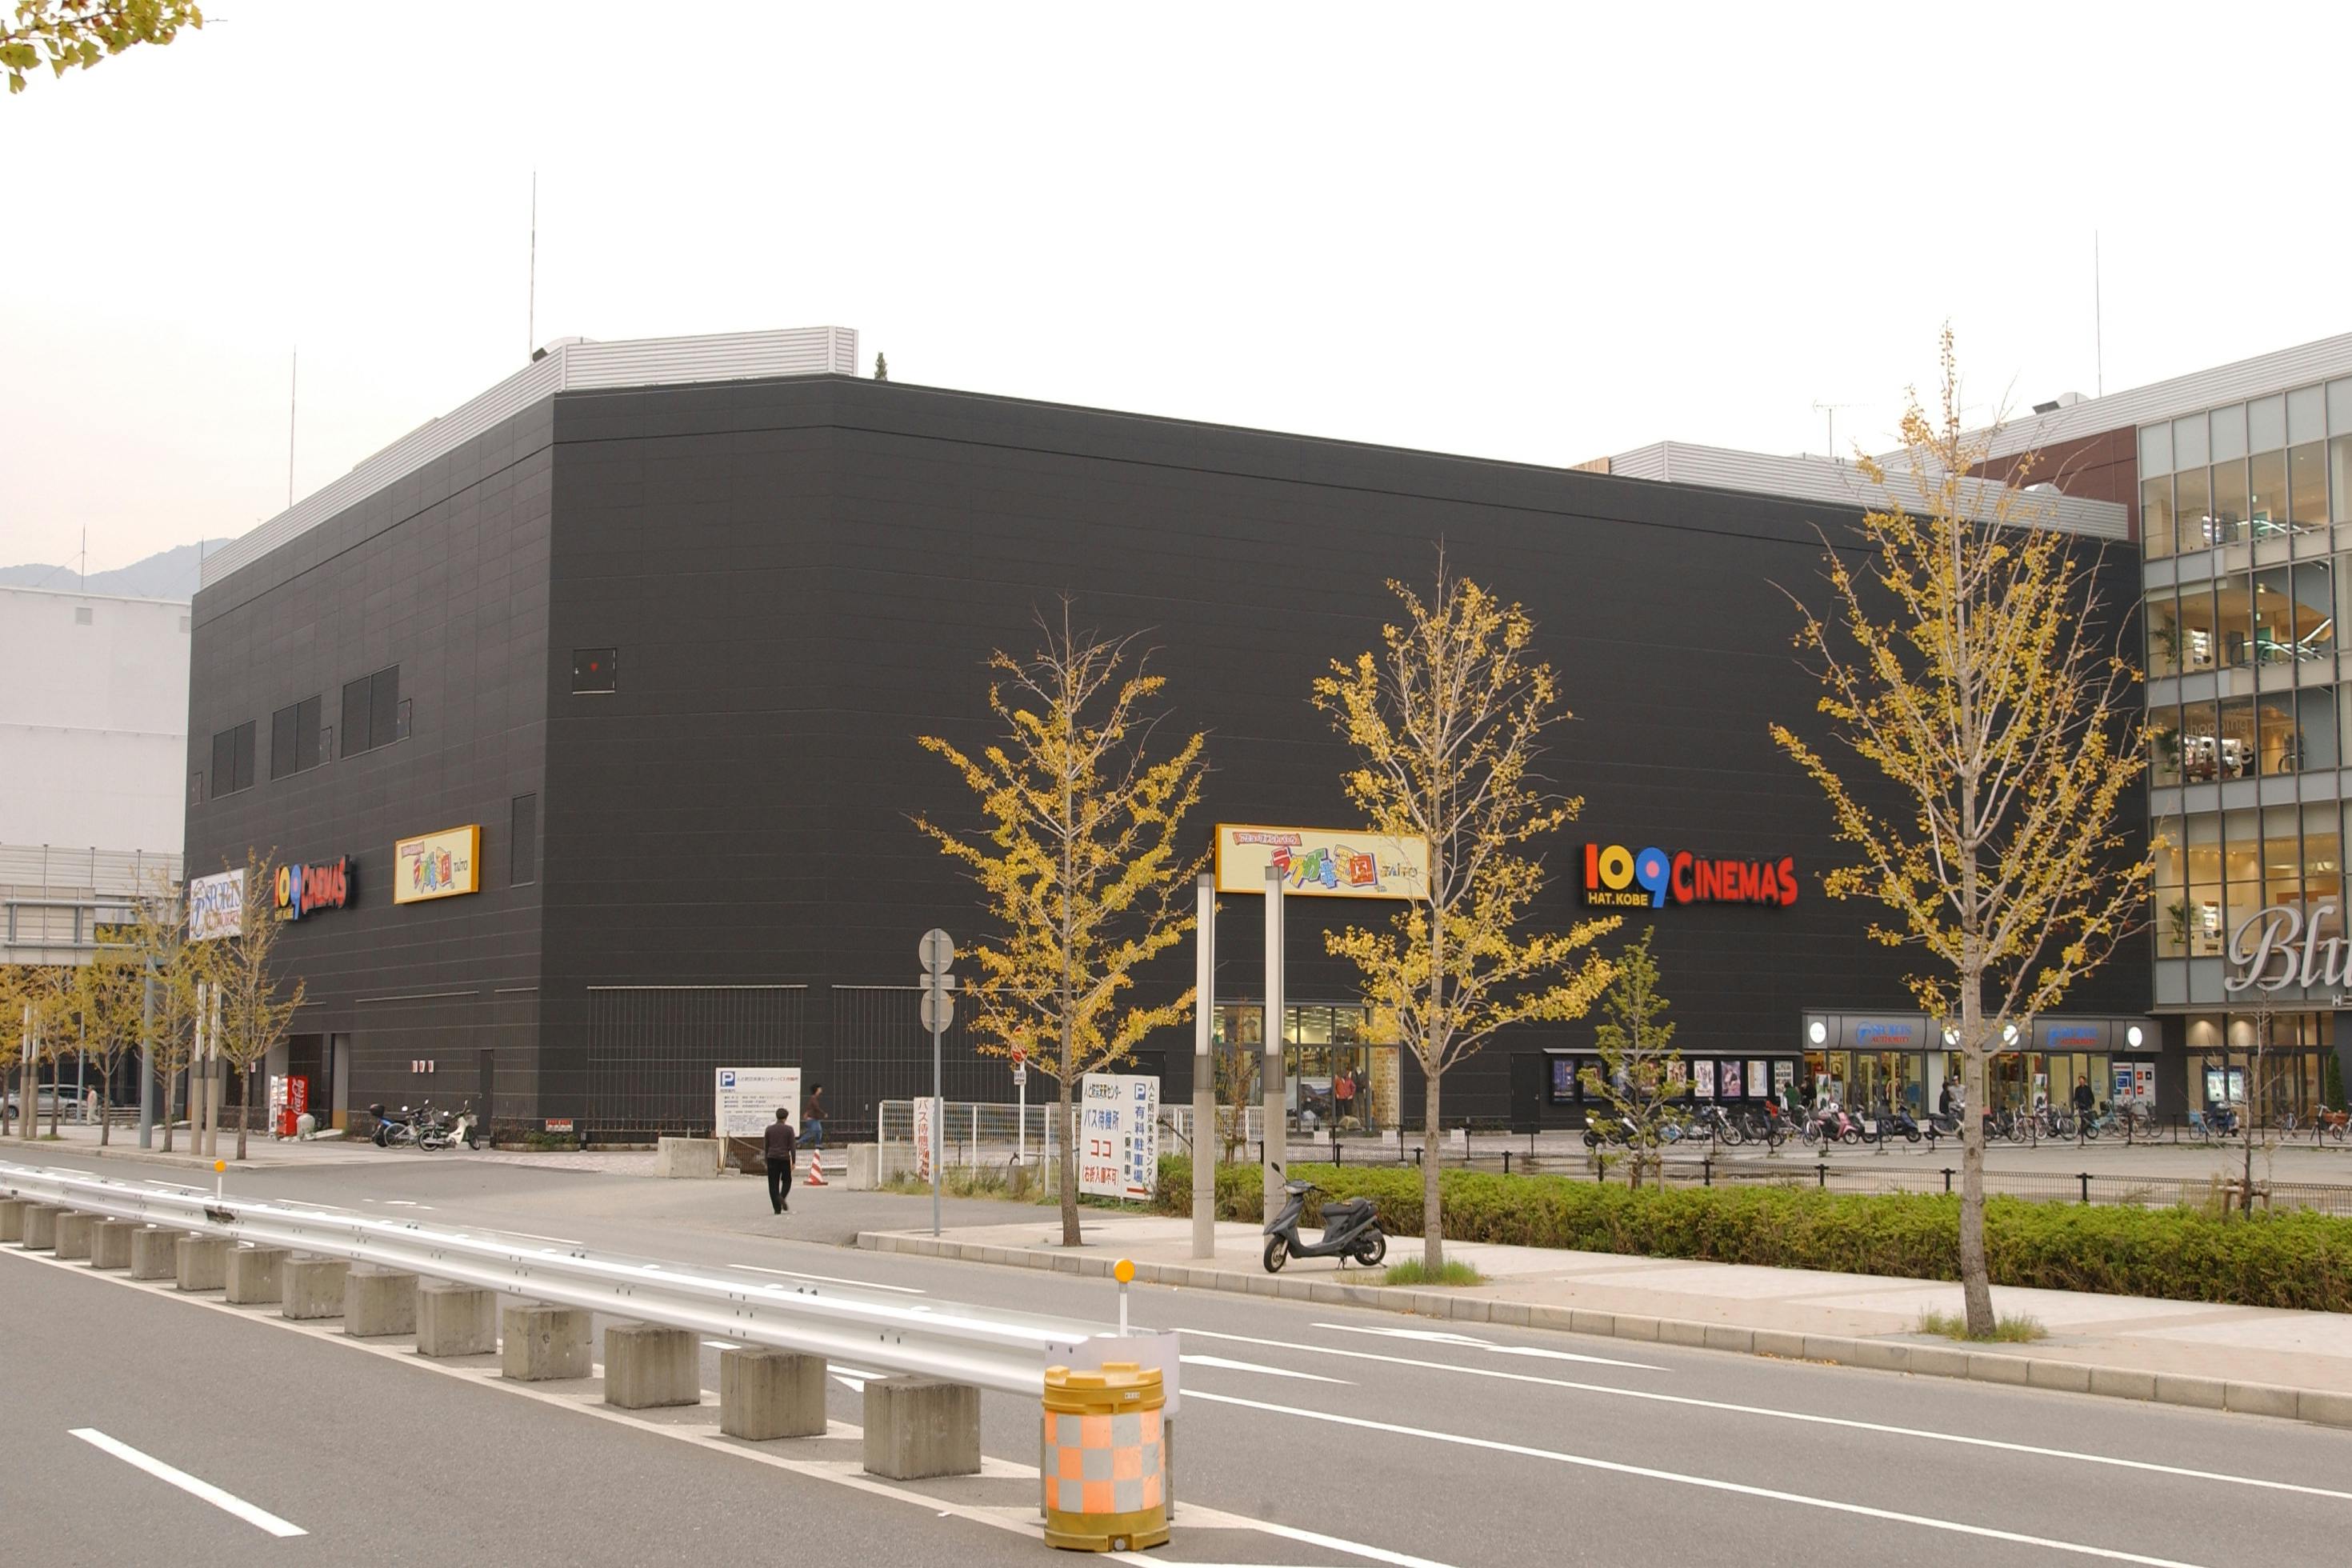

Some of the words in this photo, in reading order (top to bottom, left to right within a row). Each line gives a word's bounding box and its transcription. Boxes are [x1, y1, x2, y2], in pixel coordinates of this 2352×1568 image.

[274, 863, 301, 920] 109
[1586, 843, 1670, 908] 109
[1672, 850, 1798, 906] CINEMAS
[1090, 1139, 1111, 1158] ココ
[1134, 1106, 1144, 1183] 有料駐車場
